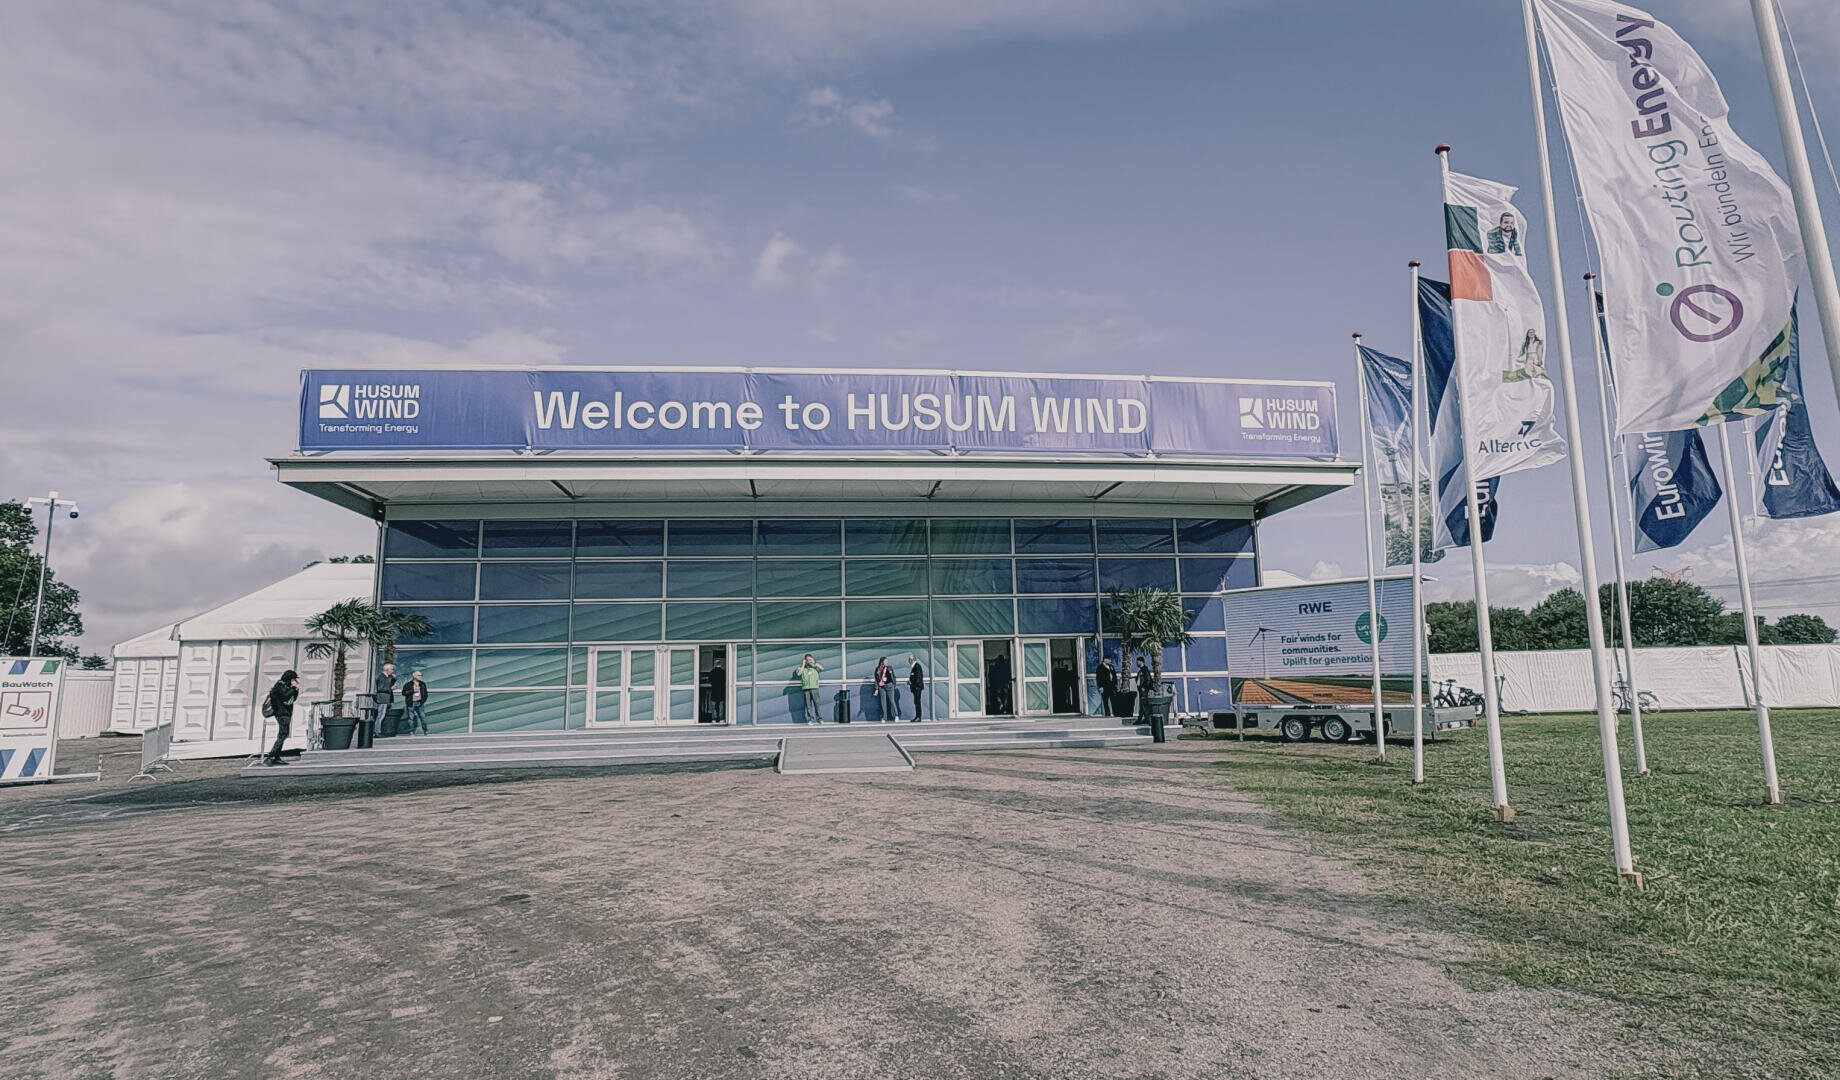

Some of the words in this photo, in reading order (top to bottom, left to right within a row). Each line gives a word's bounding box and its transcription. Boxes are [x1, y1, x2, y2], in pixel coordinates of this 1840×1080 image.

[1615, 13, 1672, 139] Energy
[1698, 116, 1719, 149] En
[1703, 152, 1743, 227] bündeln
[1650, 139, 1712, 268] Routing
[1727, 232, 1755, 263] Wir
[354, 384, 420, 398] HUSUM
[354, 399, 420, 419] WIND
[533, 391, 764, 430] Welcome
[778, 395, 832, 431] to
[846, 393, 1016, 434] HUSUM
[1029, 396, 1149, 436] WIND
[1266, 398, 1319, 412] HUSUM
[319, 423, 383, 434] Transforming
[384, 423, 418, 433] Energy
[1266, 411, 1320, 430] WIND
[1240, 432, 1293, 443] Transforming
[1293, 433, 1321, 443] Energy
[1478, 437, 1542, 454] Alterric
[1298, 601, 1333, 615] RWE
[1281, 634, 1300, 644] Fair
[1300, 633, 1326, 643] winds
[1327, 632, 1342, 641] for
[1281, 645, 1342, 655] communities.
[1282, 657, 1307, 667] Uplift
[1309, 656, 1323, 665] for
